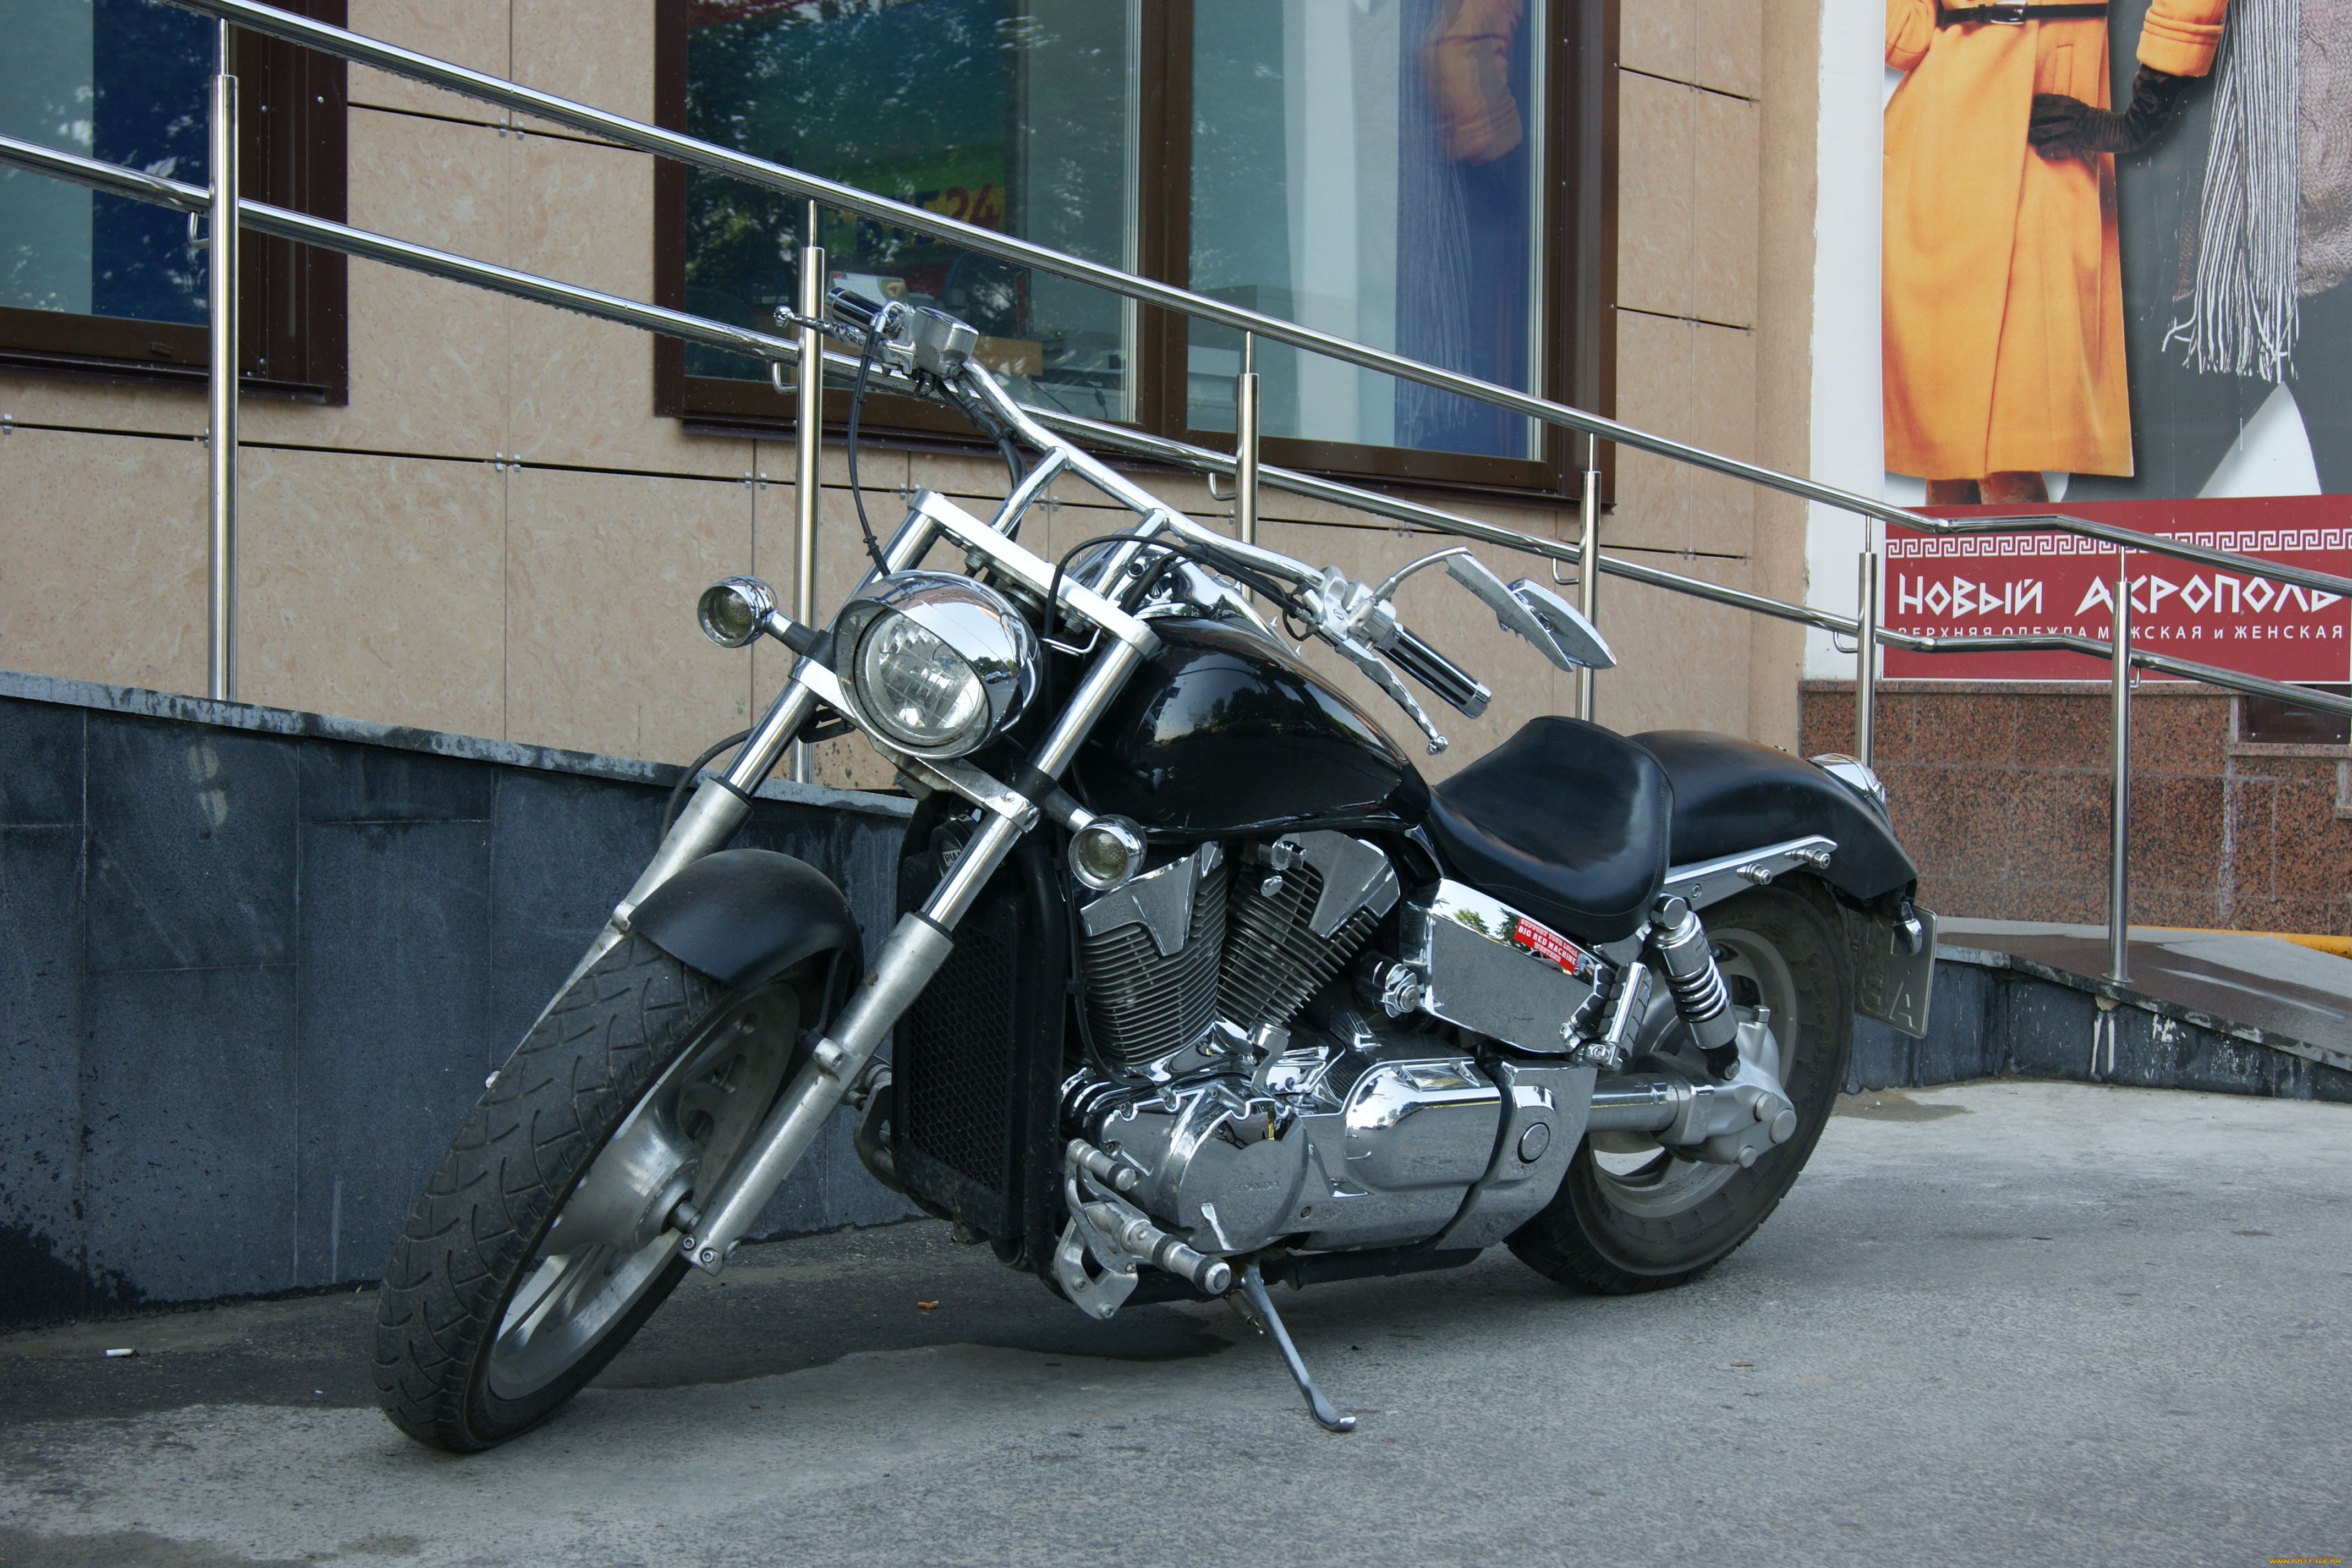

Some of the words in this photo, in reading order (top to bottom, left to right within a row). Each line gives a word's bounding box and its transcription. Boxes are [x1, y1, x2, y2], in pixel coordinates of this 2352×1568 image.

[1899, 573, 2042, 618] НОВЫЙ
[2098, 626, 2201, 639] МЖСКАЯ
[2234, 625, 2342, 639] ЖЕНСКАЯ
[1518, 925, 1532, 937] BIG
[1532, 933, 1547, 945] RED
[1548, 941, 1577, 966] MACHINE
[1232, 1180, 1280, 1193] HONDA
